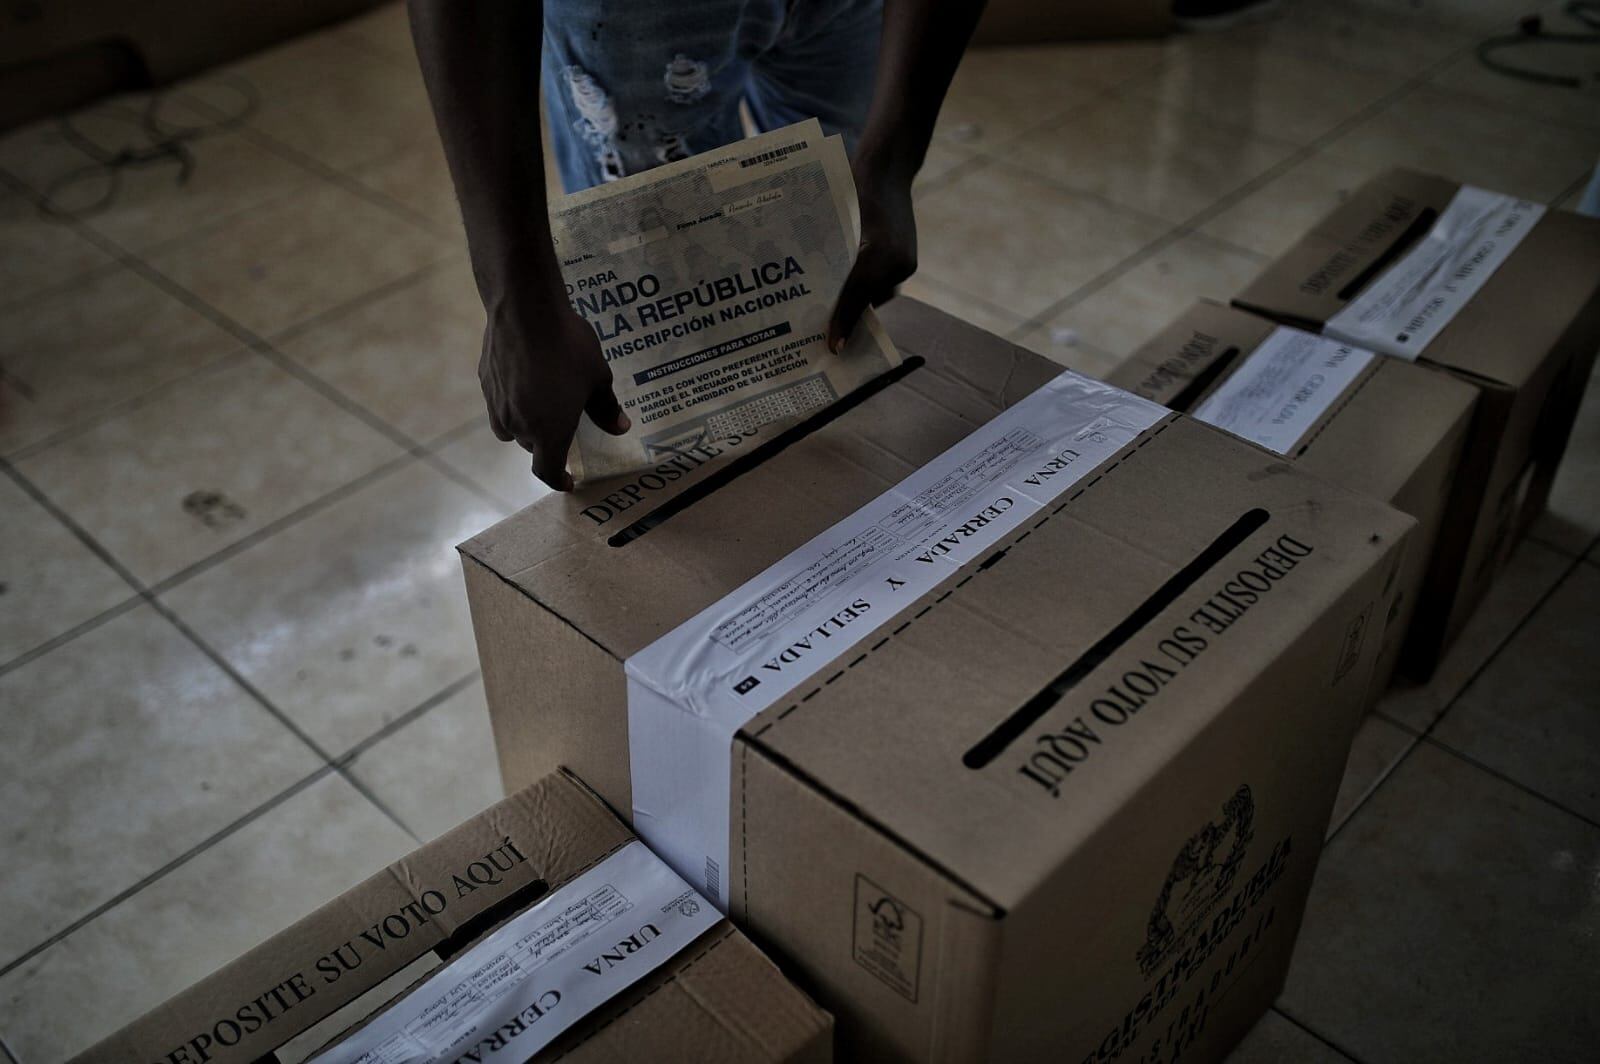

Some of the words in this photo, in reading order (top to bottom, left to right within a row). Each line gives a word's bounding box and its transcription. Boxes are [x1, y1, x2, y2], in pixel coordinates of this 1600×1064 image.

[572, 274, 660, 319] NADO
[578, 270, 618, 291] PARA
[595, 313, 634, 341] LA
[637, 256, 805, 327] REPÚBLICA
[603, 311, 716, 362] UNSCRIPCIÓN
[721, 282, 812, 323] NACIONAL
[647, 349, 719, 380] INSTRUCCIONES
[719, 340, 745, 354] PARA
[745, 328, 777, 346] VOTAR
[624, 400, 636, 409] SU
[637, 390, 661, 404] LISTA
[662, 386, 674, 395] ES
[675, 377, 695, 390] CON
[696, 368, 721, 382] VOTO
[722, 348, 779, 374] PREFERENTE
[781, 333, 826, 353] (ABIERTA)
[641, 395, 678, 413] MARQUE
[679, 389, 691, 399] EL
[692, 373, 740, 395] RECUADRO
[741, 367, 754, 377] DE
[755, 363, 767, 372] LA
[768, 353, 793, 368] LISTA
[795, 350, 802, 358] Y
[641, 409, 670, 424] LUEGO
[671, 404, 684, 413] EL
[685, 384, 736, 408] CANDIDATO
[736, 380, 749, 389] DE
[750, 375, 763, 384] SU
[579, 445, 724, 527] DEPOSITE
[1023, 448, 1081, 488] URNA
[916, 497, 1015, 565] CERRADA
[886, 577, 906, 592] Y
[1190, 534, 1314, 636] DEPOSITE
[762, 598, 872, 674] SELLADA
[1157, 625, 1209, 668] SU
[1090, 659, 1179, 728] VOTO
[1016, 717, 1103, 798] AQUÍ
[153, 973, 315, 1064] EPOSITE
[316, 941, 362, 984] SU
[360, 890, 447, 950] VOTO
[452, 836, 528, 899] AQUÍ
[583, 924, 662, 976] URNA
[456, 989, 562, 1064] CERRA
